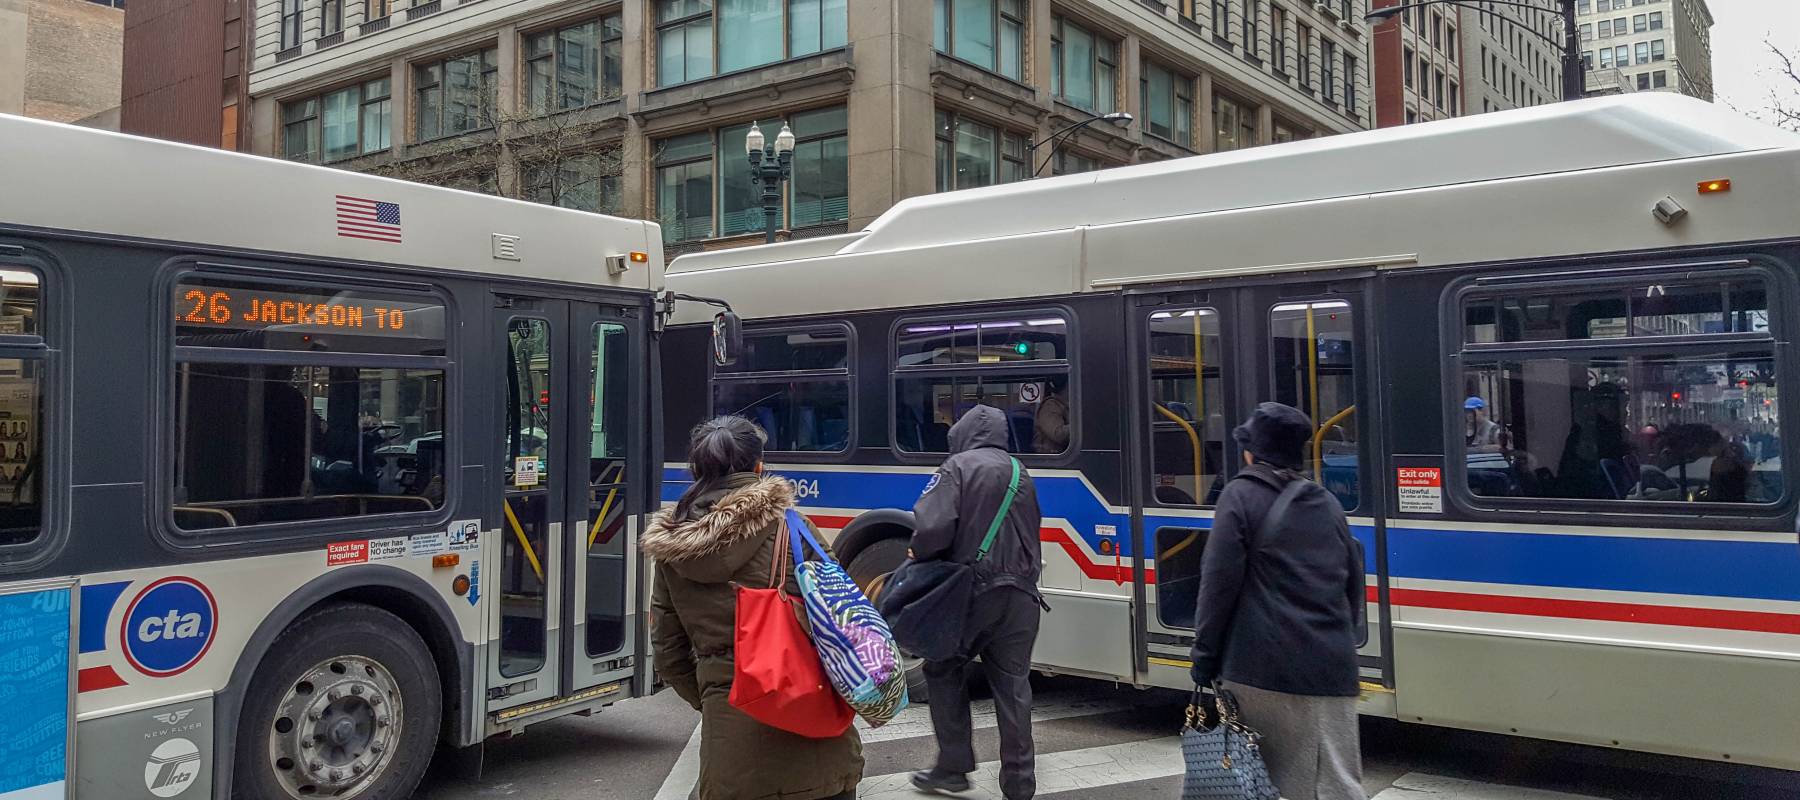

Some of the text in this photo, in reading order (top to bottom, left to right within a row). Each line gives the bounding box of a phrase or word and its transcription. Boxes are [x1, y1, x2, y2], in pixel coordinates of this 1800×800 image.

[176, 290, 404, 329] 26 JACKSON TO
[1400, 469, 1438, 480] Exit only
[329, 542, 365, 553] Exact fare
[370, 539, 404, 549] Driver has
[329, 550, 359, 560] required
[370, 548, 381, 556] NO
[382, 546, 407, 555] change
[138, 609, 202, 643] cta
[144, 722, 202, 740] NEW FLYER
